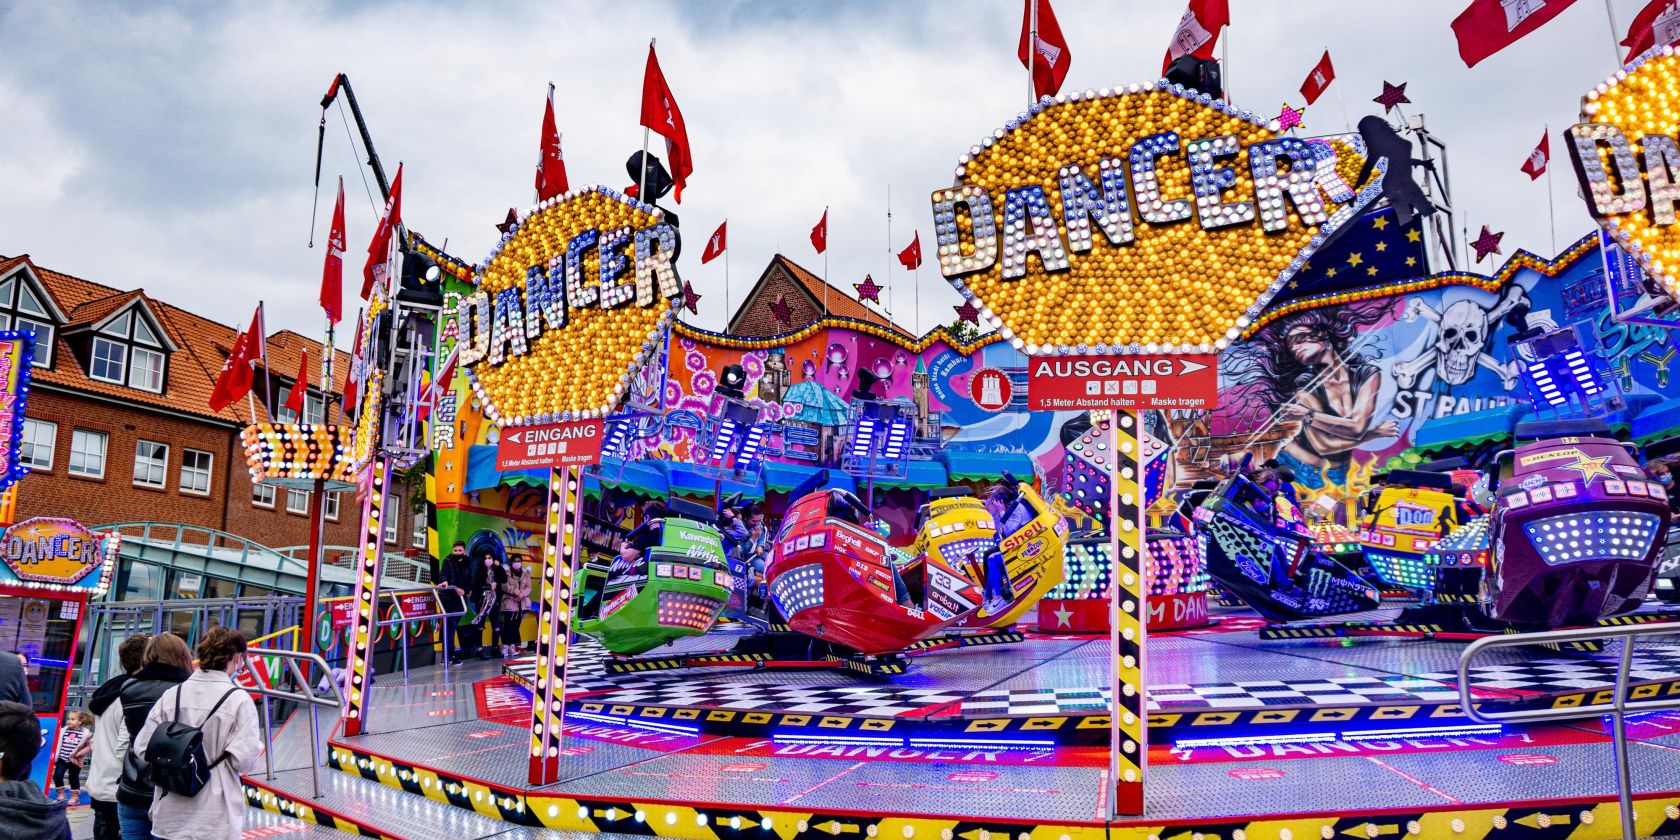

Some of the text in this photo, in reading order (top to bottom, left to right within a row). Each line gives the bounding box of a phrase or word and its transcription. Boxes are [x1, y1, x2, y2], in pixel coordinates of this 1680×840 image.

[930, 131, 1329, 280] DANCER
[457, 222, 682, 367] DANCER
[1034, 359, 1173, 378] AUSGANG
[1040, 399, 1051, 408] 1,5
[1053, 399, 1074, 407] Meter
[1076, 398, 1109, 407] Abstand
[1110, 398, 1135, 406] halten
[1151, 397, 1176, 406] Maske
[1178, 397, 1205, 408] tragen
[525, 424, 596, 443] EINGANG
[509, 459, 521, 467] Meter
[521, 458, 539, 466] Abstand
[539, 457, 553, 465] halten
[562, 455, 577, 463] Maske
[577, 454, 593, 463] tragen
[1532, 450, 1578, 461] DUNLOP
[680, 530, 718, 547] Kawasaki
[1004, 521, 1043, 550] Shell
[6, 533, 98, 564] DANCER
[687, 544, 721, 564] Ninja
[1021, 540, 1044, 558] PENNZOIL
[1240, 560, 1261, 579] Ford
[934, 571, 951, 590] 33
